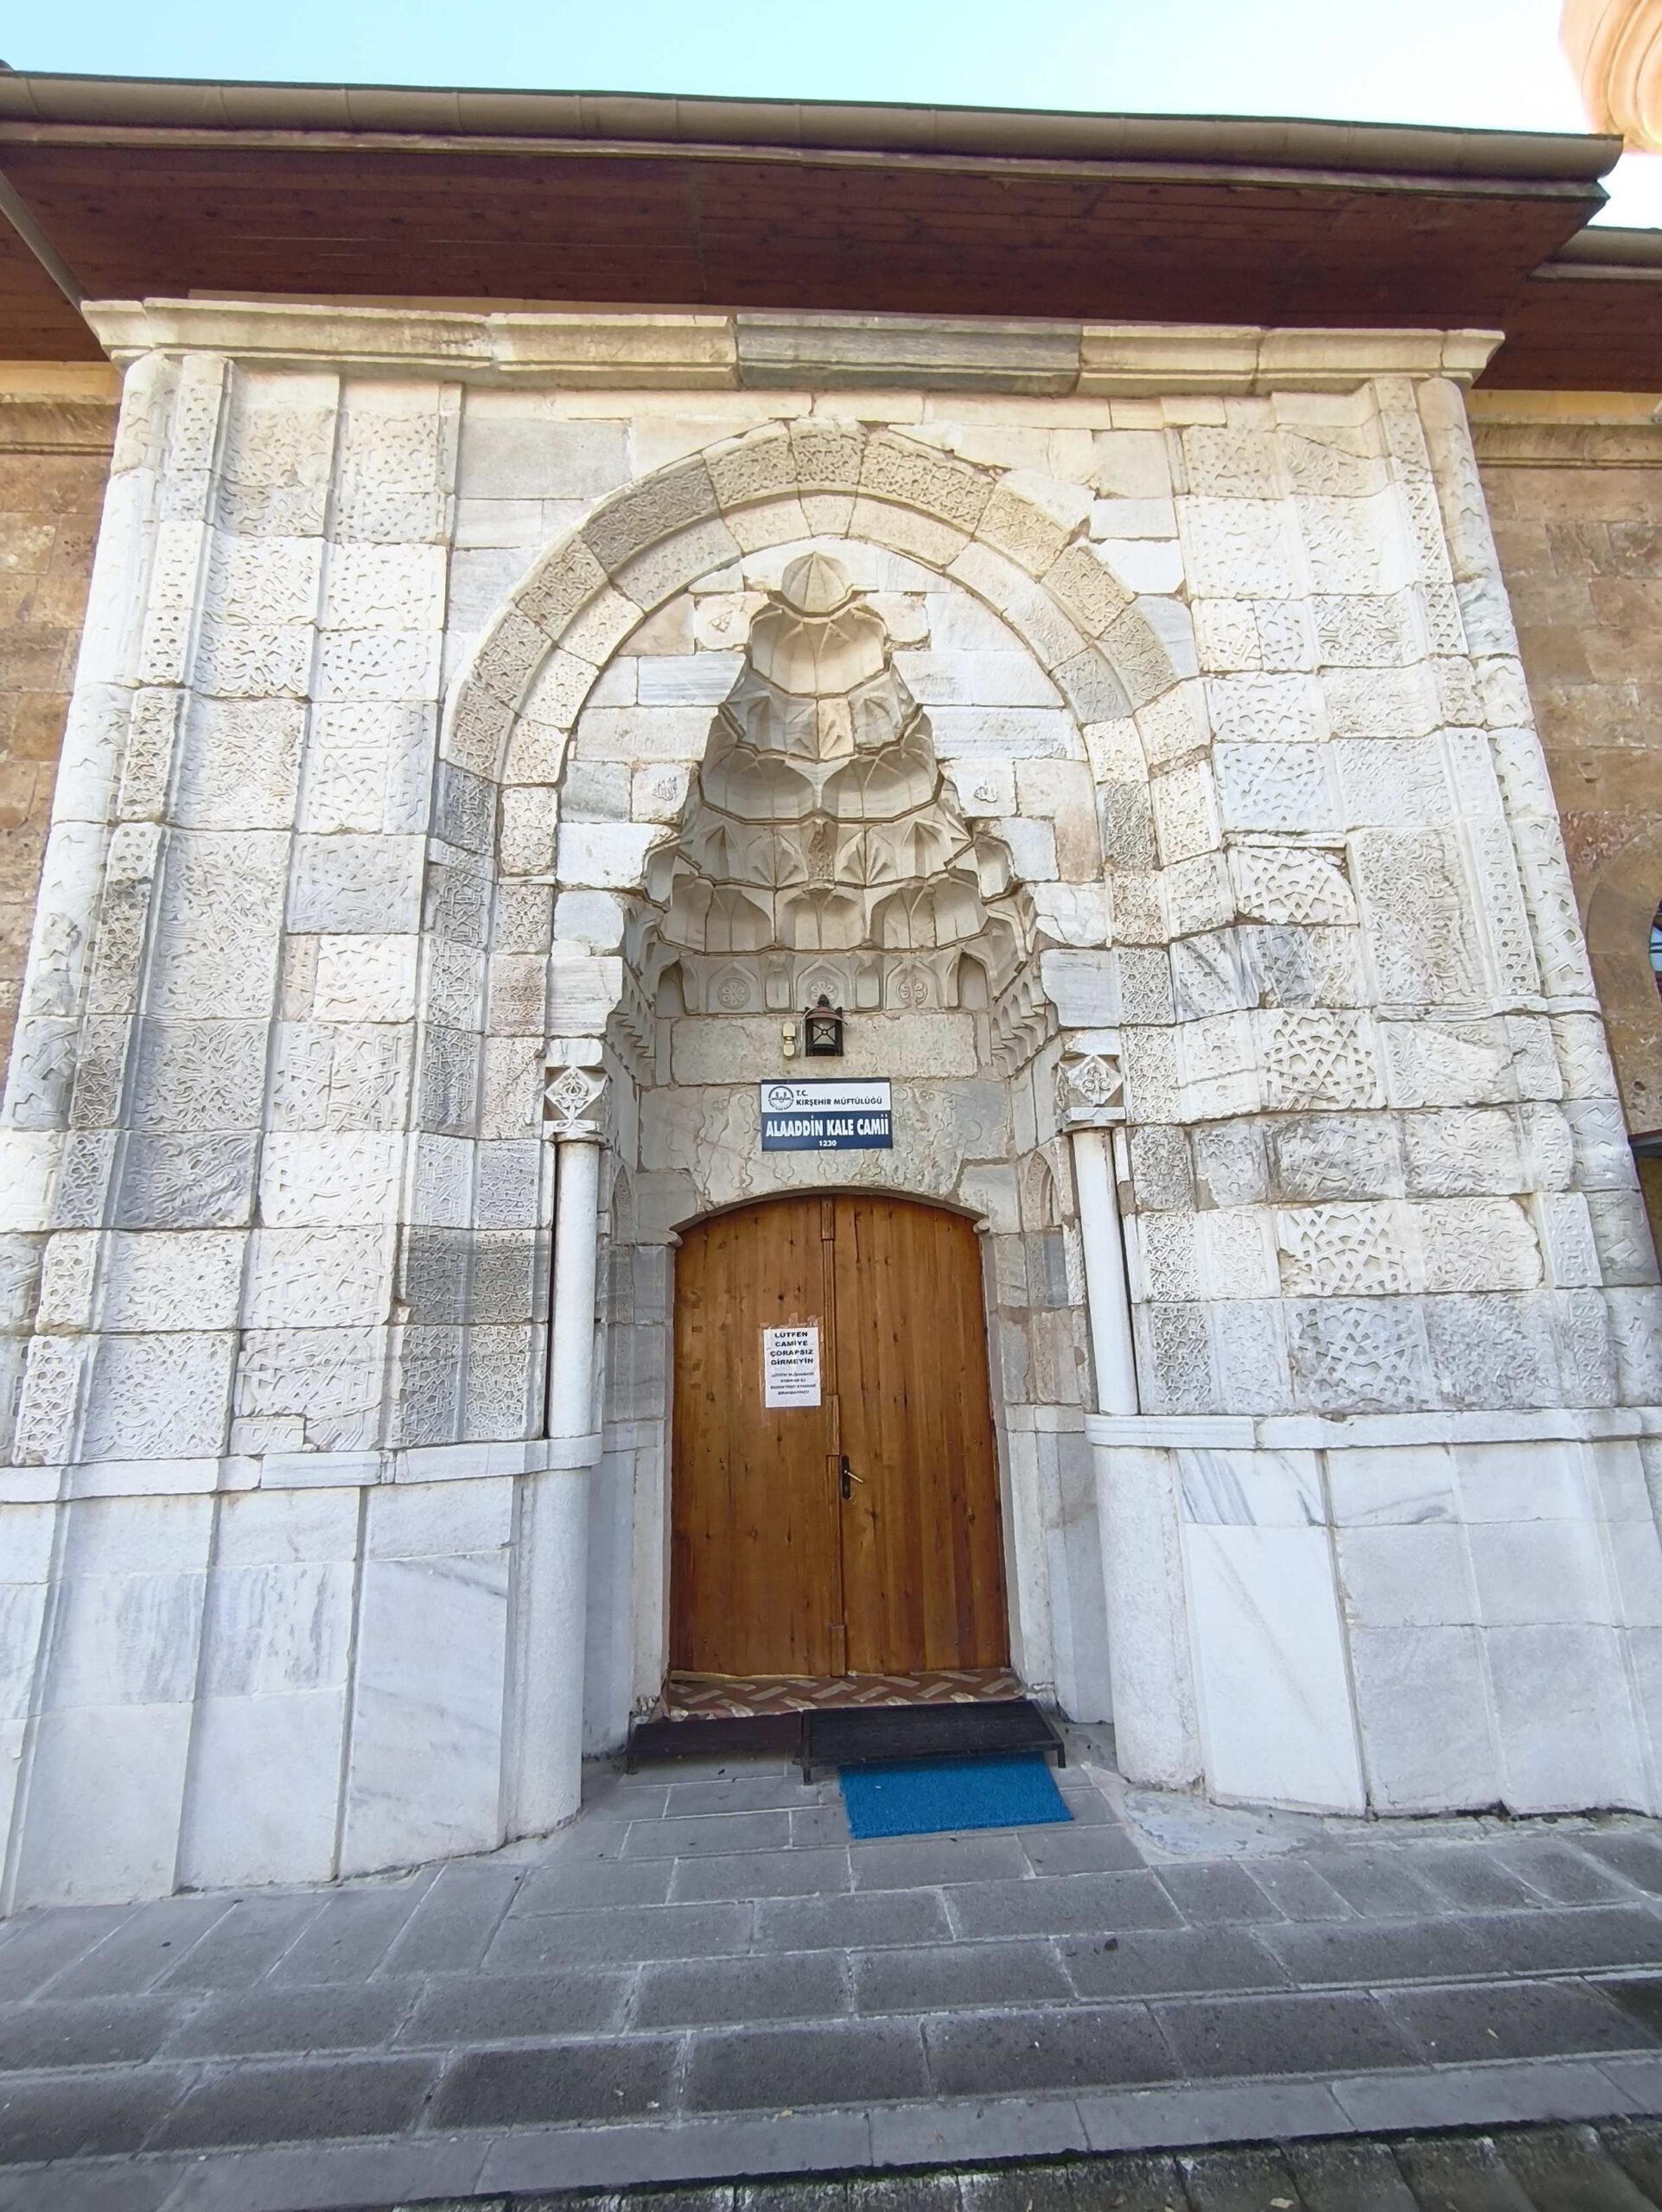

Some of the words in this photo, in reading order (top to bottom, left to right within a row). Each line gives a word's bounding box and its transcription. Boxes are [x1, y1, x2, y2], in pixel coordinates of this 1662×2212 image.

[796, 1097, 831, 1107] KIRŞEHİR
[833, 1096, 882, 1105] MÜFTÜLÜĞÜ
[766, 1115, 823, 1137] ALAADDİN
[826, 1119, 854, 1136] KALE
[856, 1114, 889, 1135] CAMİİ
[770, 1349, 813, 1357] ÇORAPSIZ
